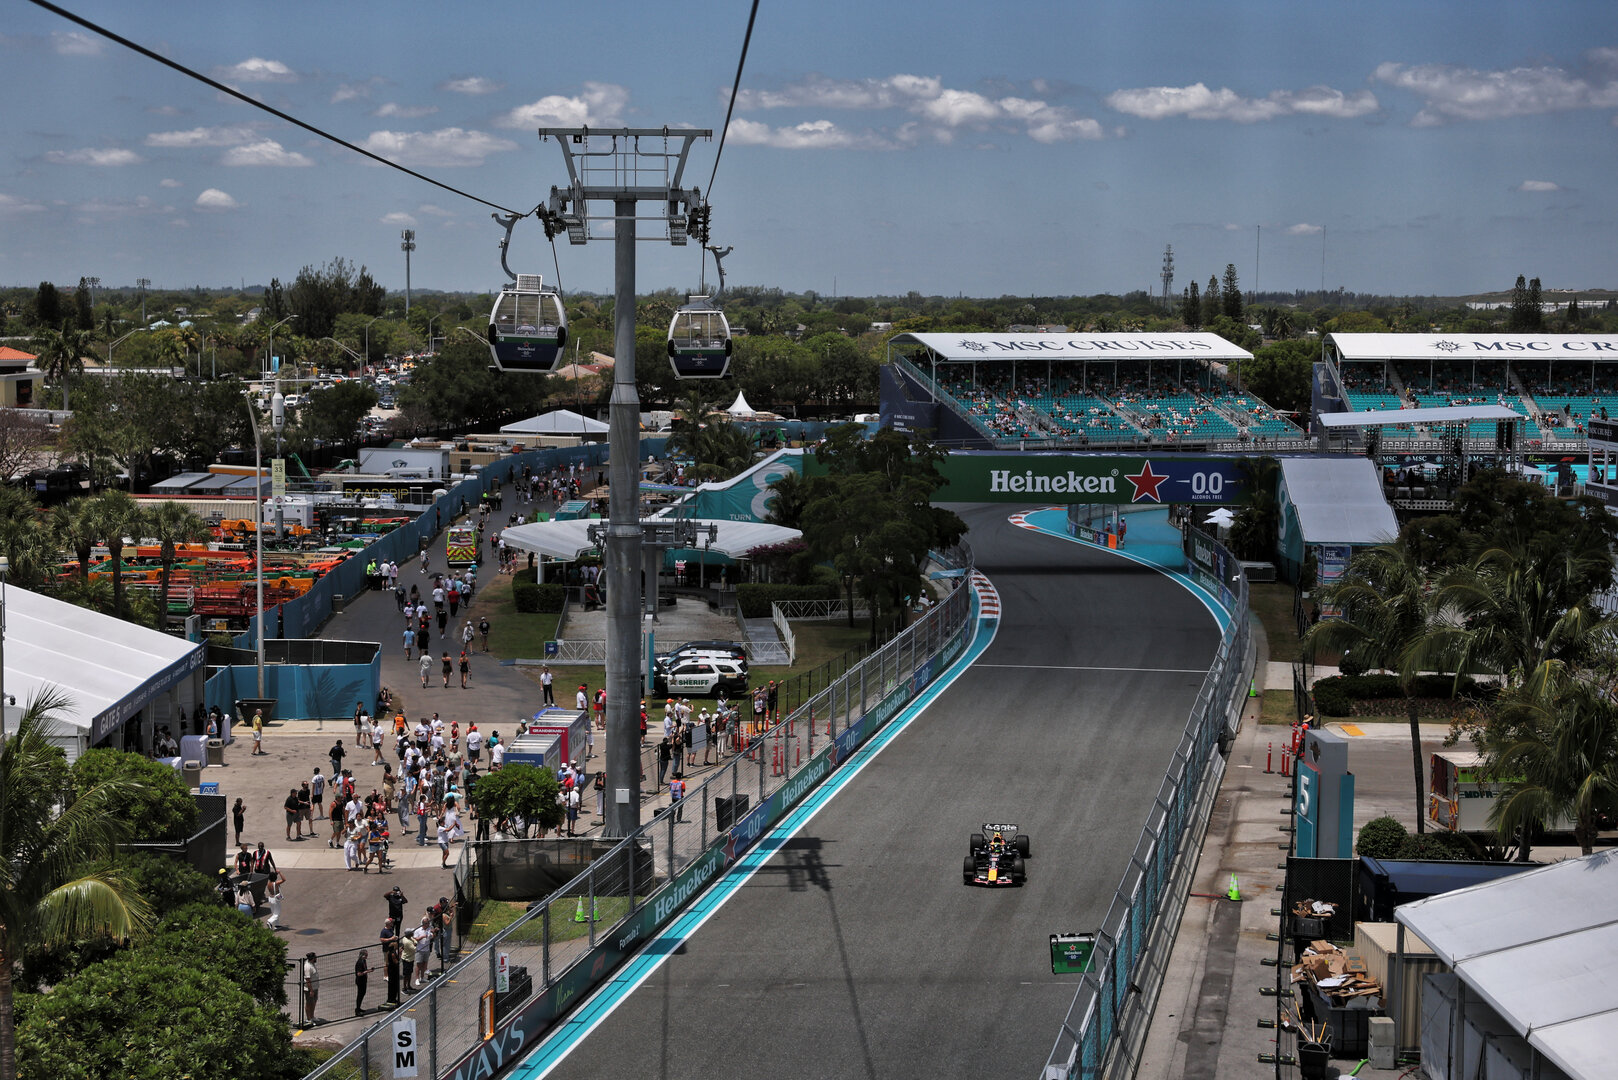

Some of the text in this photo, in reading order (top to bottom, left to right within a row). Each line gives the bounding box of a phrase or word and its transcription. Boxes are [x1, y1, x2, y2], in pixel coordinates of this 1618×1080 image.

[993, 340, 1212, 351] MSC CRUISES
[1472, 341, 1552, 351] MSC
[989, 470, 1117, 494] Heineken
[1191, 472, 1223, 495] 0.0
[729, 513, 752, 521] TURN
[875, 689, 906, 726] Heineken
[100, 710, 116, 735] GATE
[782, 761, 825, 810] Heineken
[1300, 774, 1310, 816] 5
[1464, 790, 1493, 799] MDFR
[654, 856, 717, 926] Heineken
[619, 928, 636, 951] Formula
